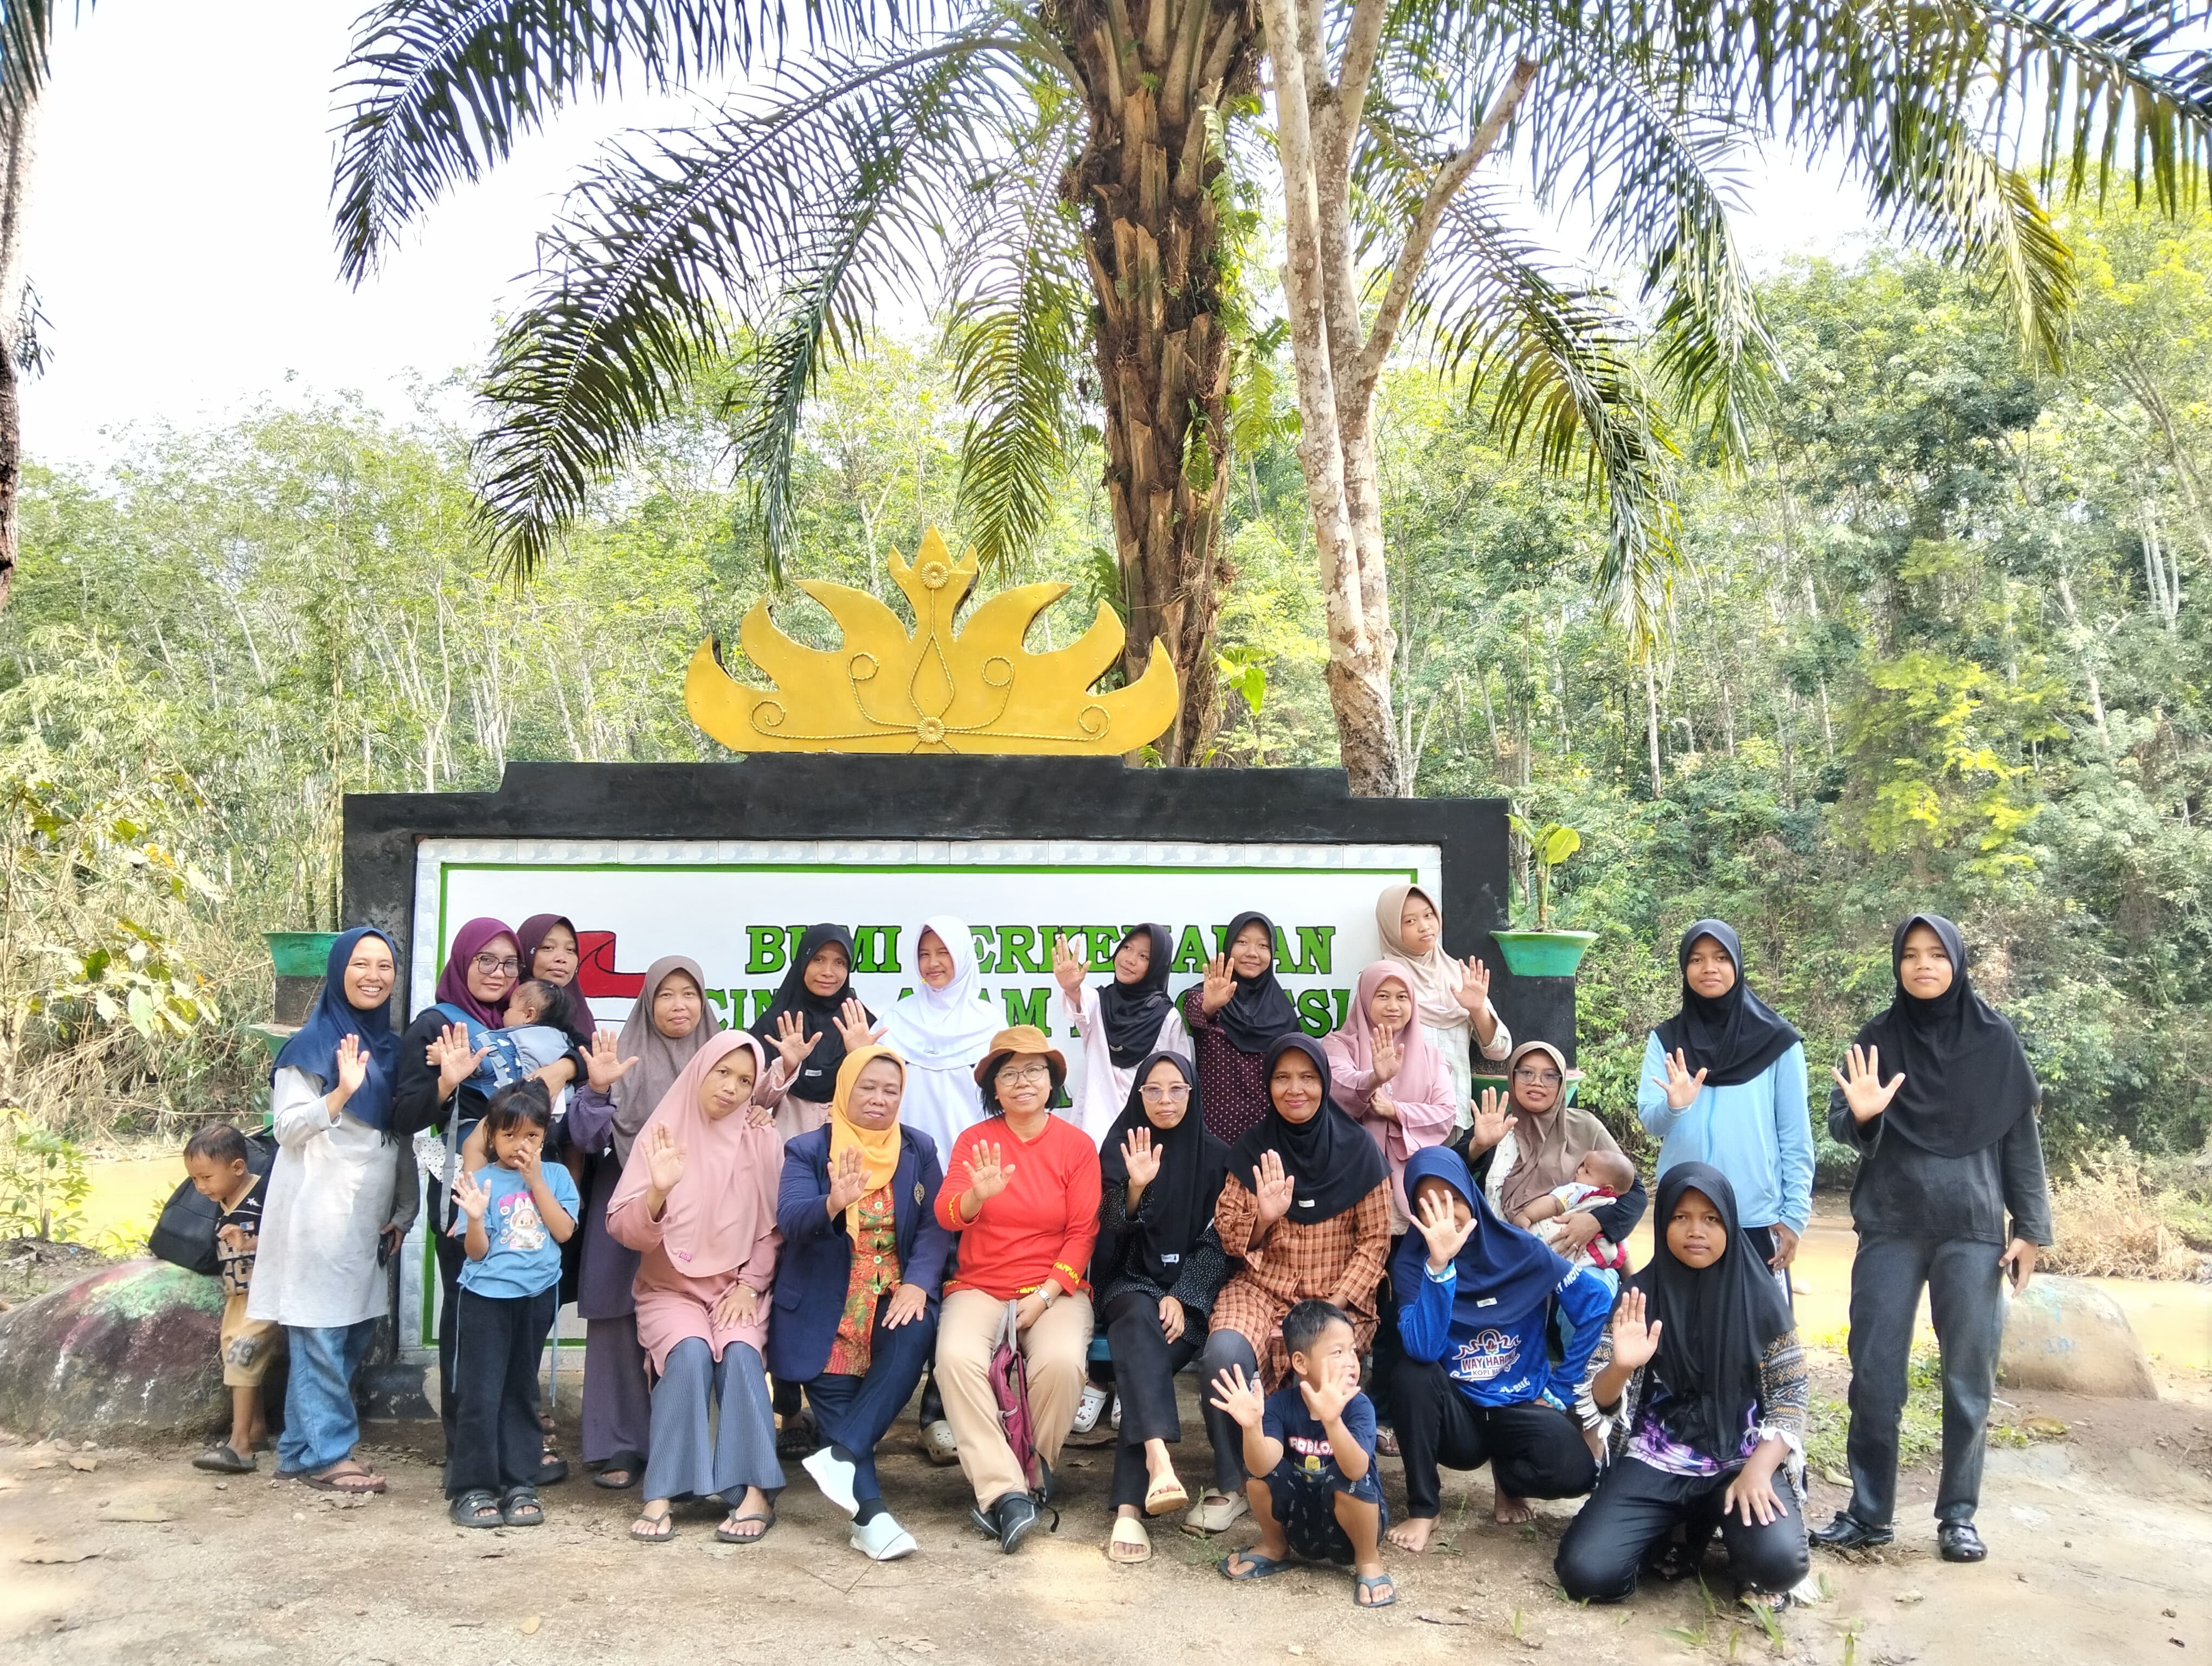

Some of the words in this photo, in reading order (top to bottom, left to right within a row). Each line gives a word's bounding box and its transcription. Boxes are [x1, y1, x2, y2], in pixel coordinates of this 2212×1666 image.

[745, 925, 902, 974] BMI
[1462, 1357, 1483, 1372] WAY
[1288, 1436, 1334, 1456] ROBLO
